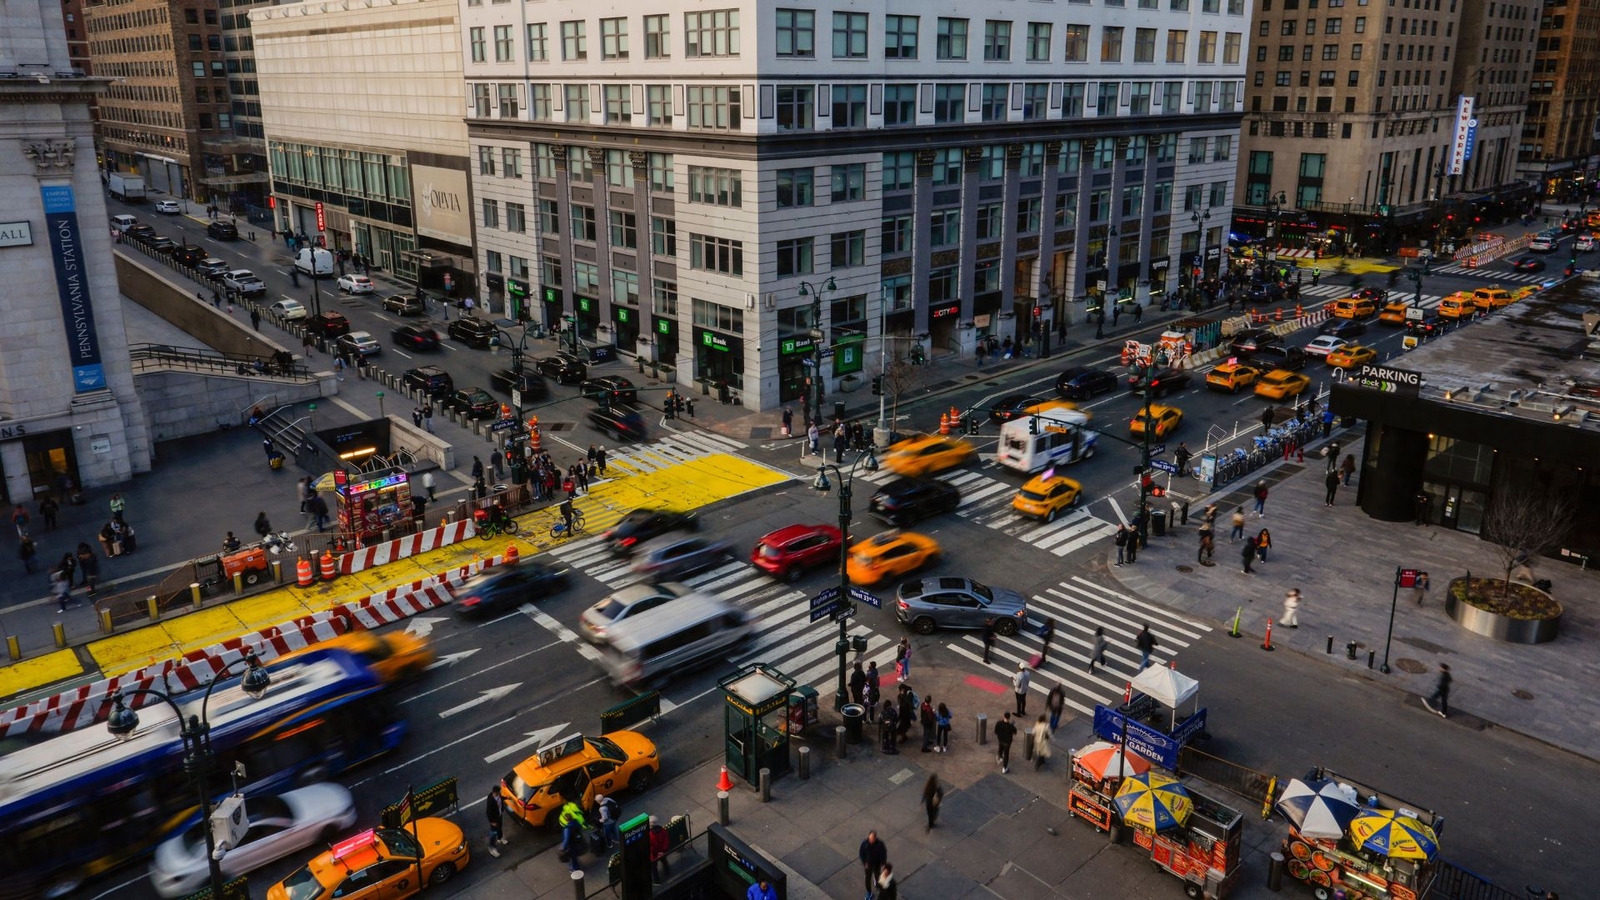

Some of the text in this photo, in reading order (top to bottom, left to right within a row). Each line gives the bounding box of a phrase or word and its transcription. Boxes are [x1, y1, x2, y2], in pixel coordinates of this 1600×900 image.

[1453, 99, 1470, 173] NEW YORKER
[430, 189, 461, 213] OLIVIA
[0, 229, 26, 240] ALL
[57, 219, 78, 271] STATION
[67, 273, 92, 359] PENNSYLVANIA
[713, 337, 727, 347] Bank
[795, 338, 811, 348] Bank
[1361, 378, 1380, 388] dock
[1362, 365, 1418, 385] PARKING
[1151, 461, 1162, 469] West
[813, 590, 837, 606] Eighth Ave
[850, 589, 863, 600] West
[872, 598, 879, 606] St
[820, 607, 831, 617] Louis
[1129, 741, 1164, 763] GARDEN
[624, 824, 648, 840] Subway
